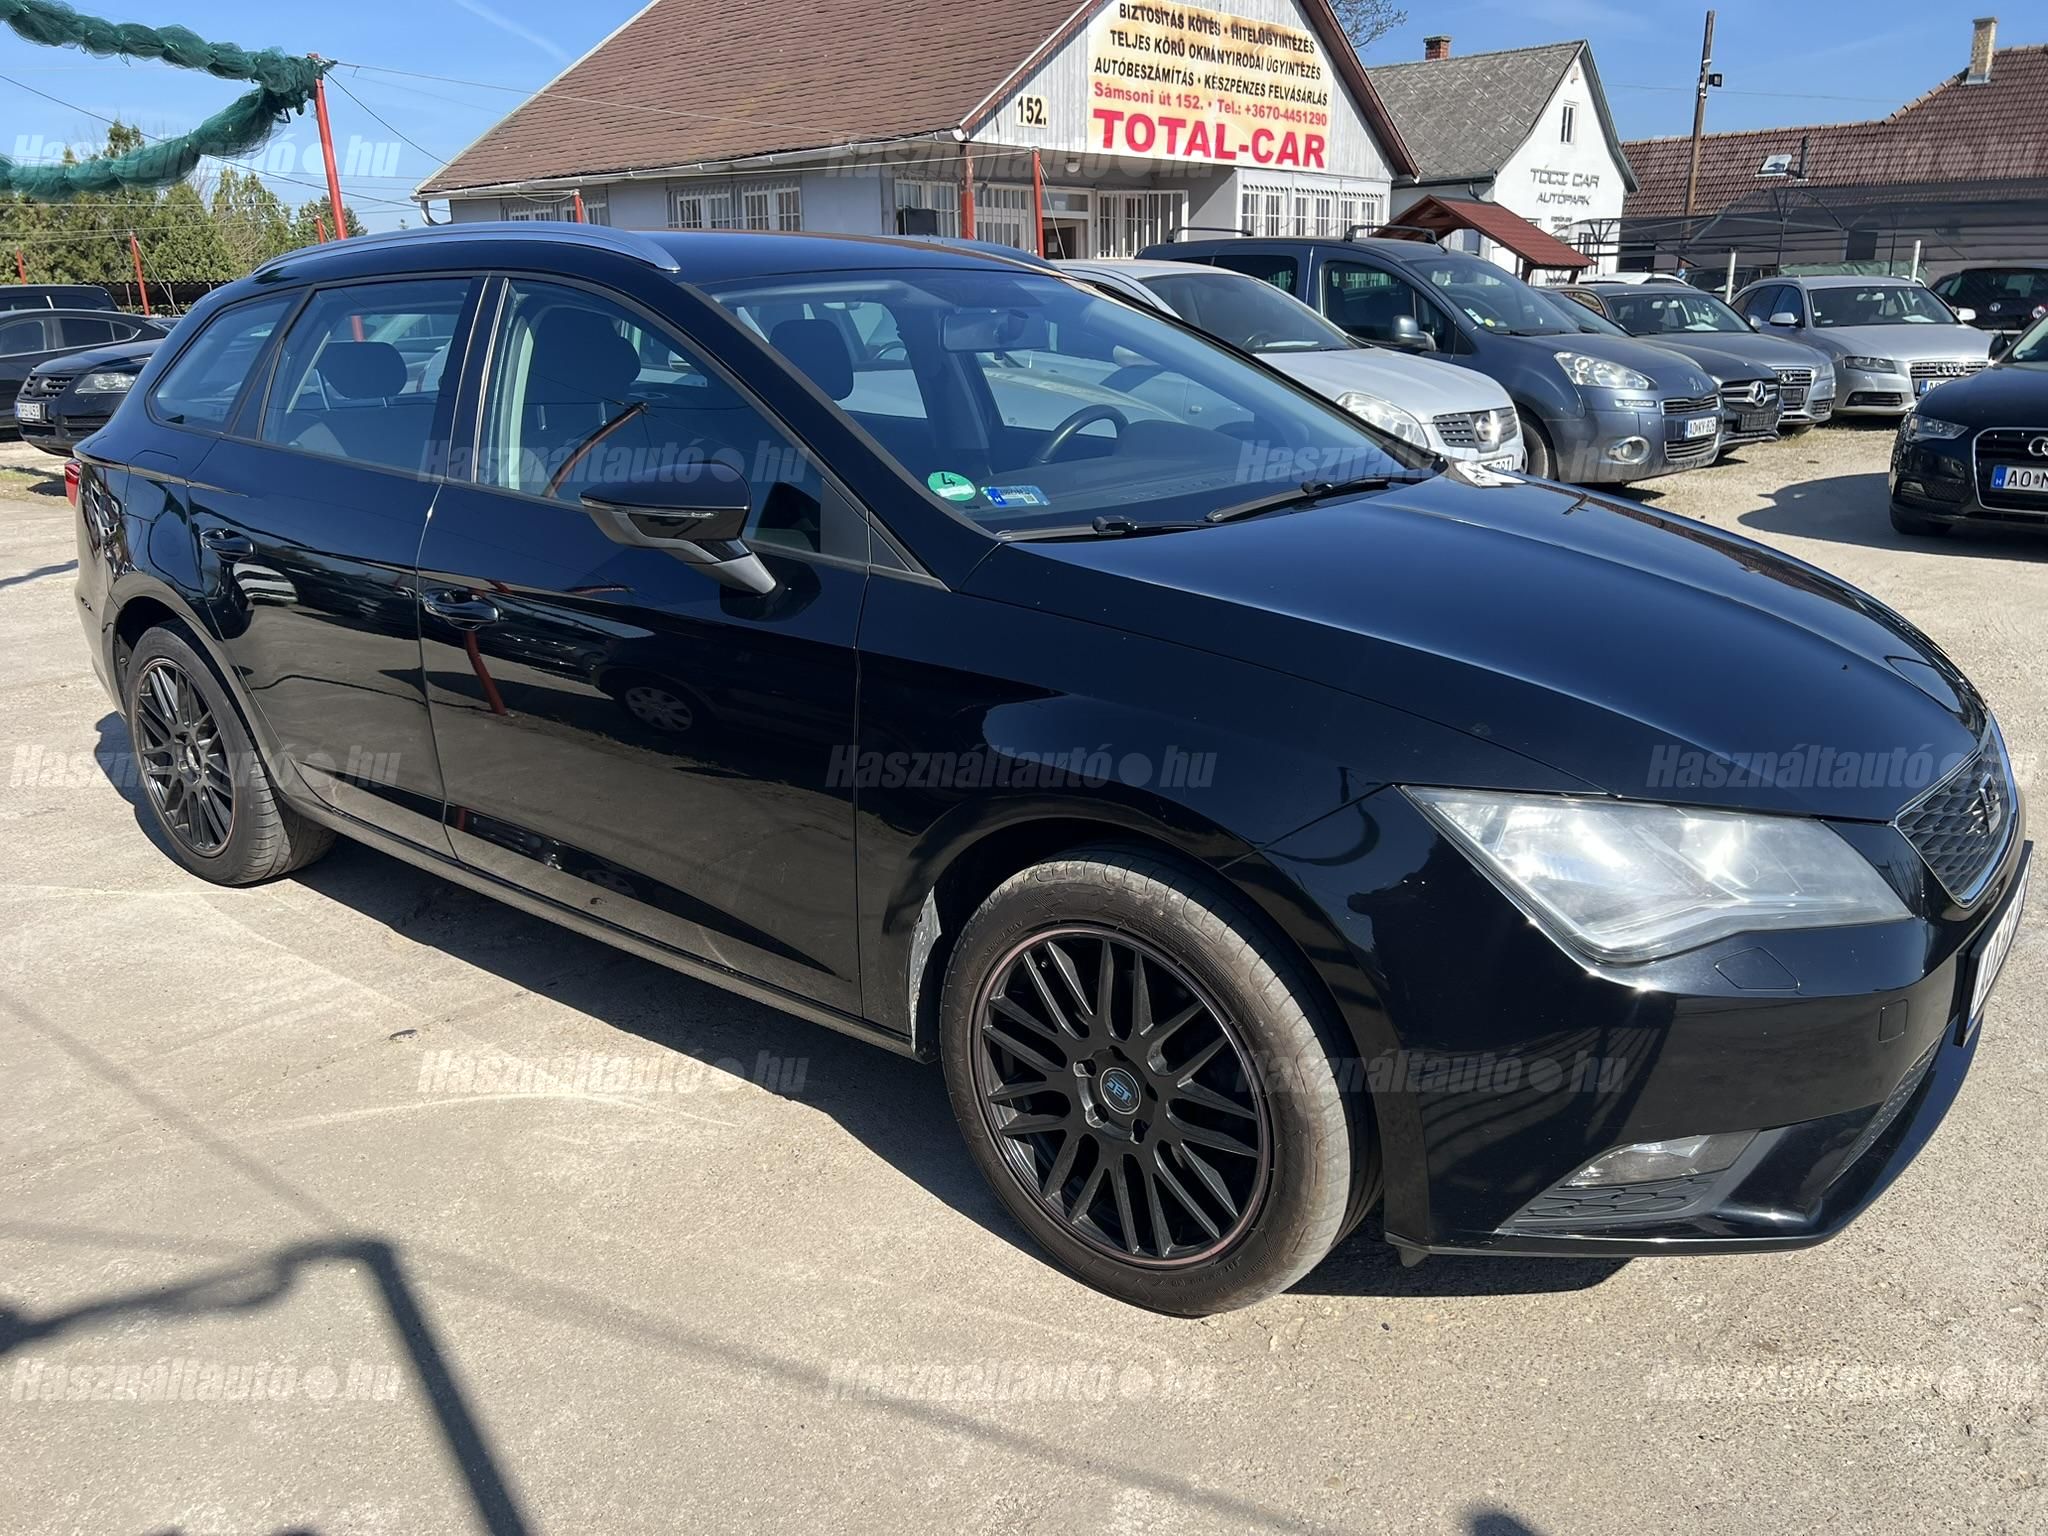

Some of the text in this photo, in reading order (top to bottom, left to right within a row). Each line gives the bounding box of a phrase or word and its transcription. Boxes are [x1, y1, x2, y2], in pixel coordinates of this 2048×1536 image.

[1119, 3, 1184, 30] BIZTOSÍTÁS
[1188, 13, 1221, 37] KÖTÉS
[1110, 30, 1151, 52] TELJES
[1189, 43, 1264, 71] OKMÁNYIRODAI
[1266, 55, 1321, 81] ÜGYINTÉZÉS
[1094, 57, 1328, 107] AUTÓBESZÁMÍTÁS KÉSZPÉNZES FELVÁSÁRLÁS
[1017, 95, 1047, 126] 152.
[1094, 81, 1328, 127] Sámsoni út 152. Tel.: +3670-4451290
[1093, 108, 1326, 169] TOTAL-CAR
[1535, 189, 1592, 206] AUTÓPARK
[1572, 172, 1600, 190] CAR
[2007, 469, 2032, 488] AO
